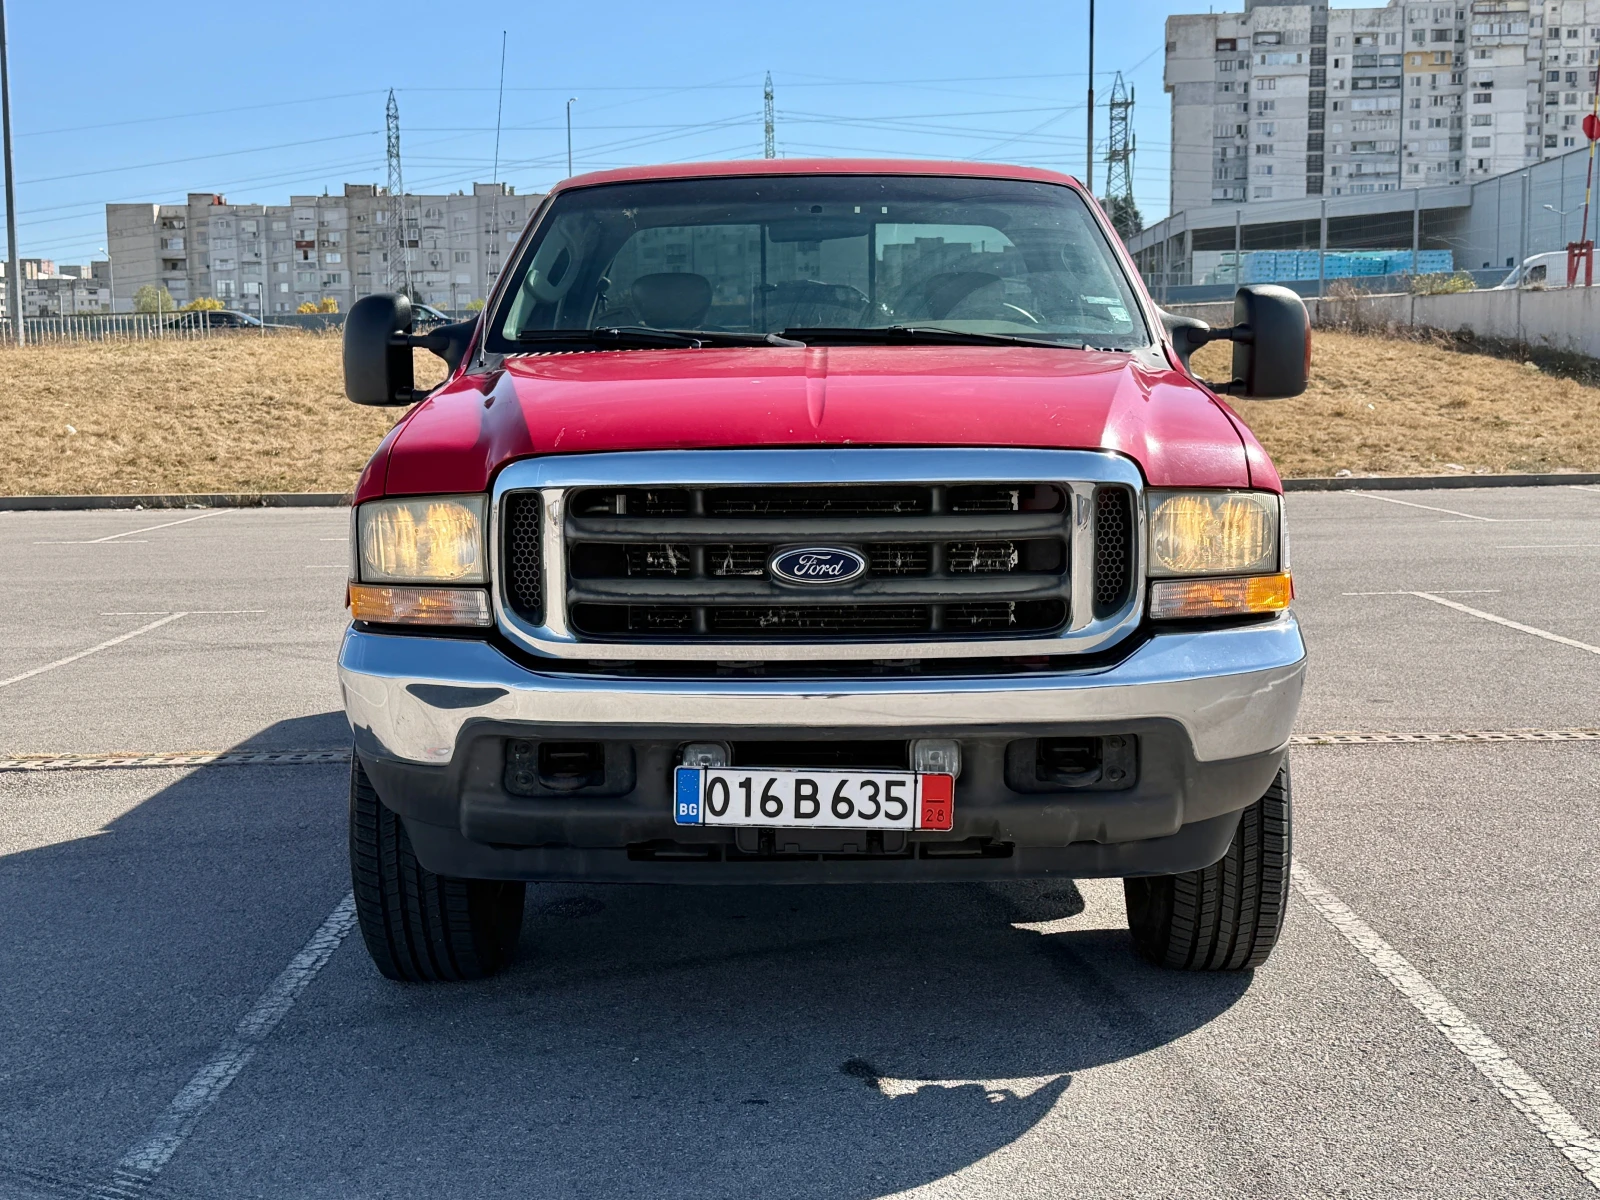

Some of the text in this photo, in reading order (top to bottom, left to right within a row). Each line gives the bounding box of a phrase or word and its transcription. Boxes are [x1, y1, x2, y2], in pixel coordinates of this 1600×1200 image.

[794, 554, 843, 576] Ford
[679, 803, 698, 816] BG
[925, 809, 945, 823] 28
